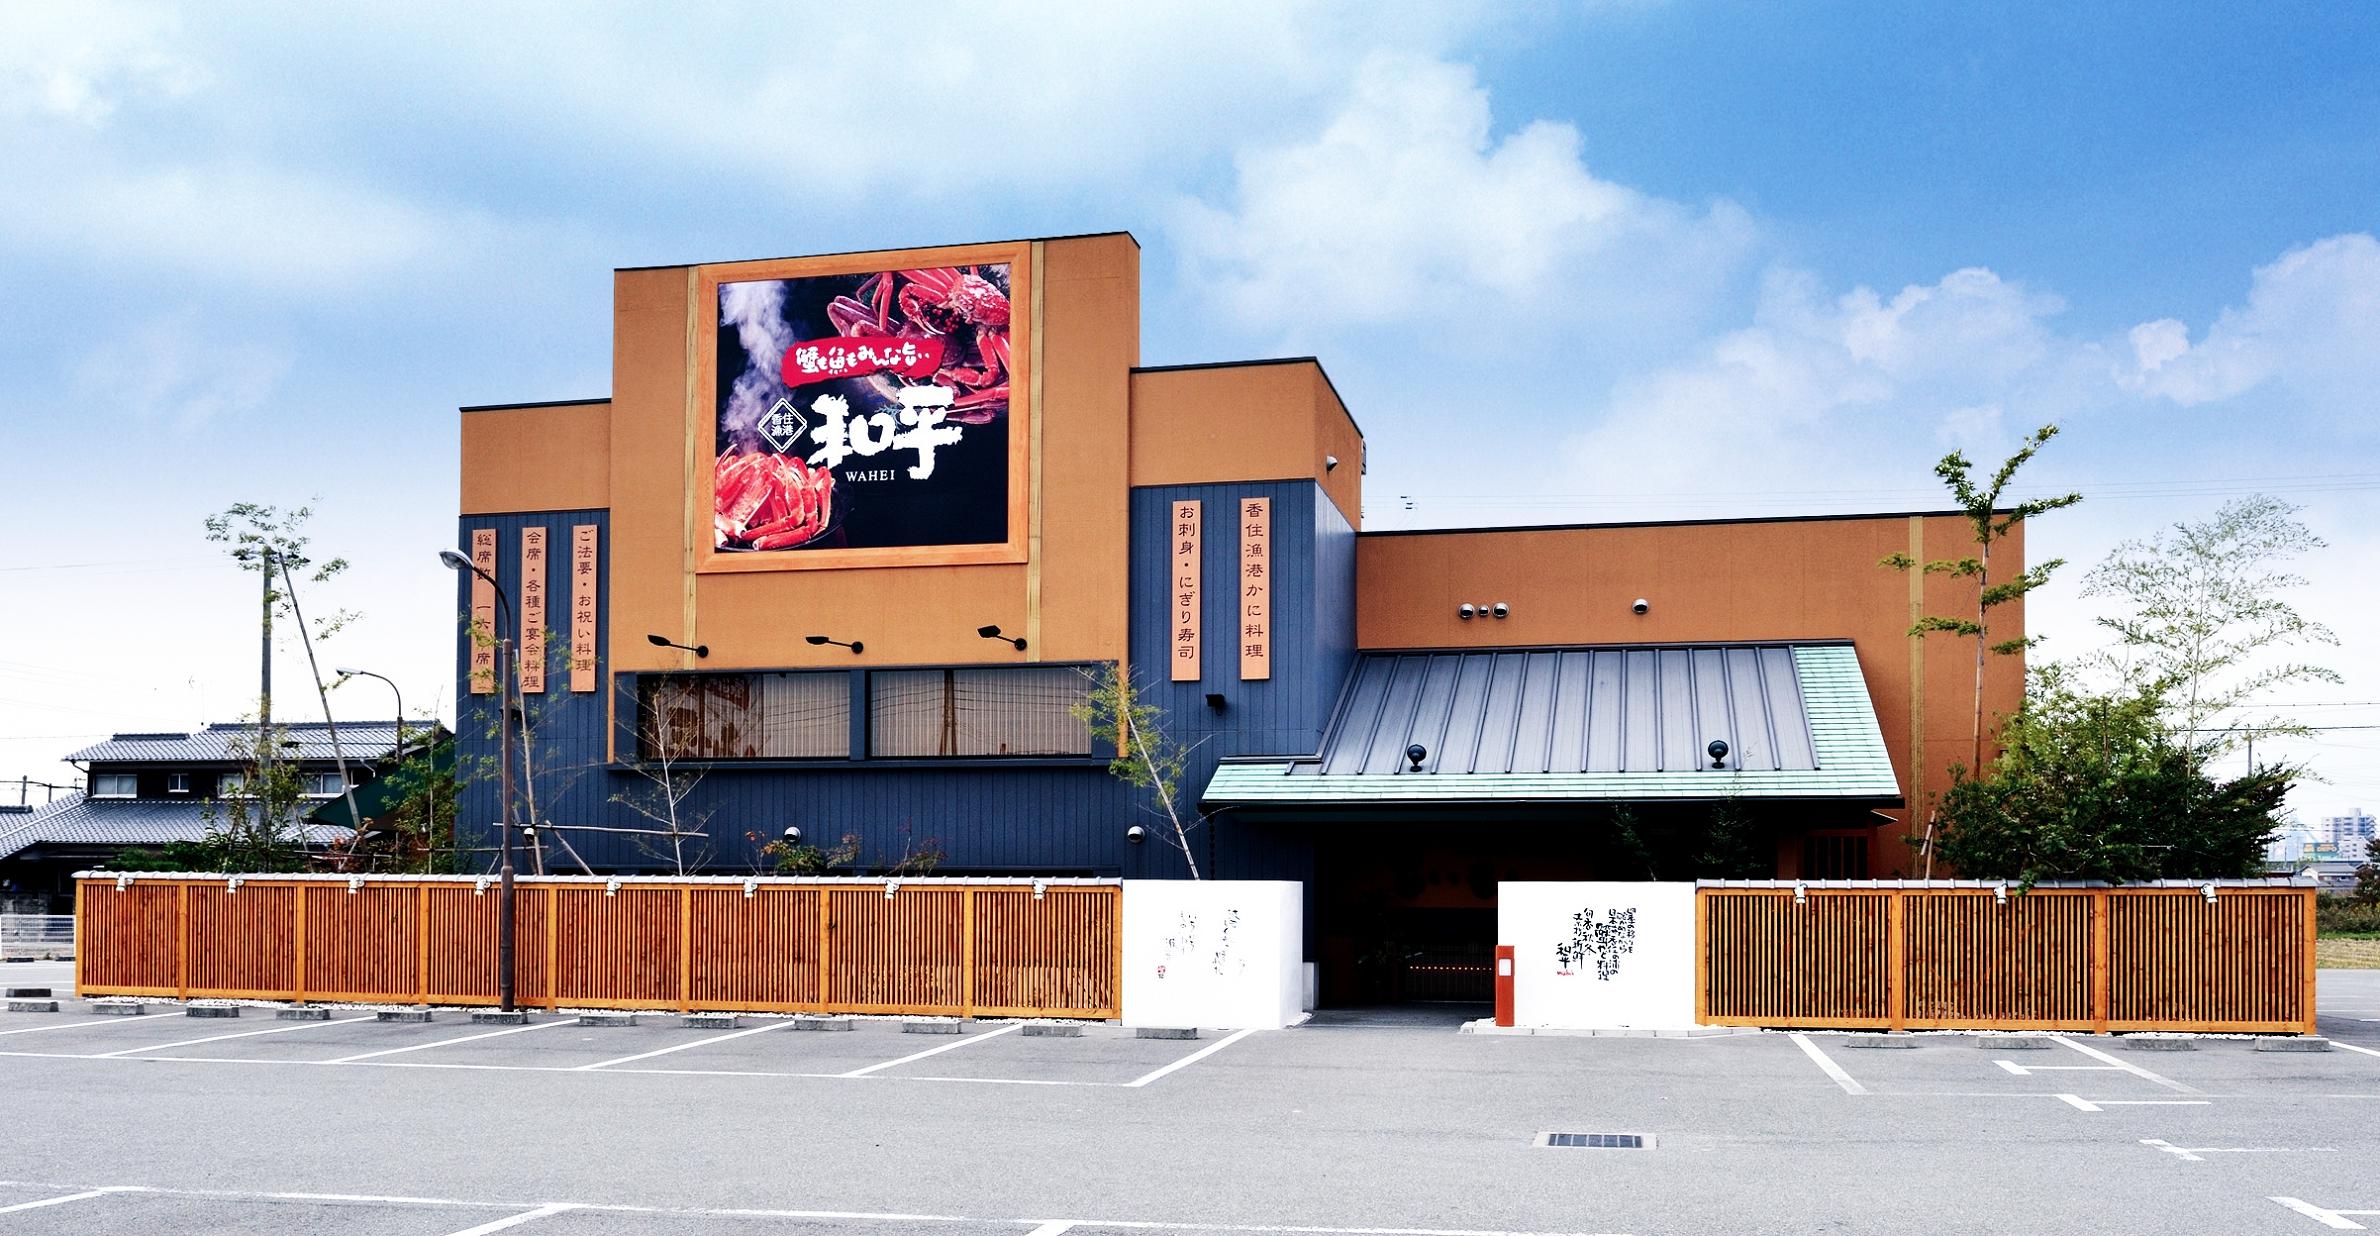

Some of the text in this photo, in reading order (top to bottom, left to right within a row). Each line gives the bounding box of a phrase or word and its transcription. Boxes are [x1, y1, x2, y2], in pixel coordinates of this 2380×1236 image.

[806, 385, 963, 480] 和平
[845, 469, 895, 482] WAHEI
[523, 531, 542, 688] 会席・各種ご宴会料理
[575, 529, 594, 672] ご法要・お祝い料理
[1178, 506, 1196, 660] お刺身・にぎり寿司
[1245, 503, 1264, 658] 香住漁港かに料理
